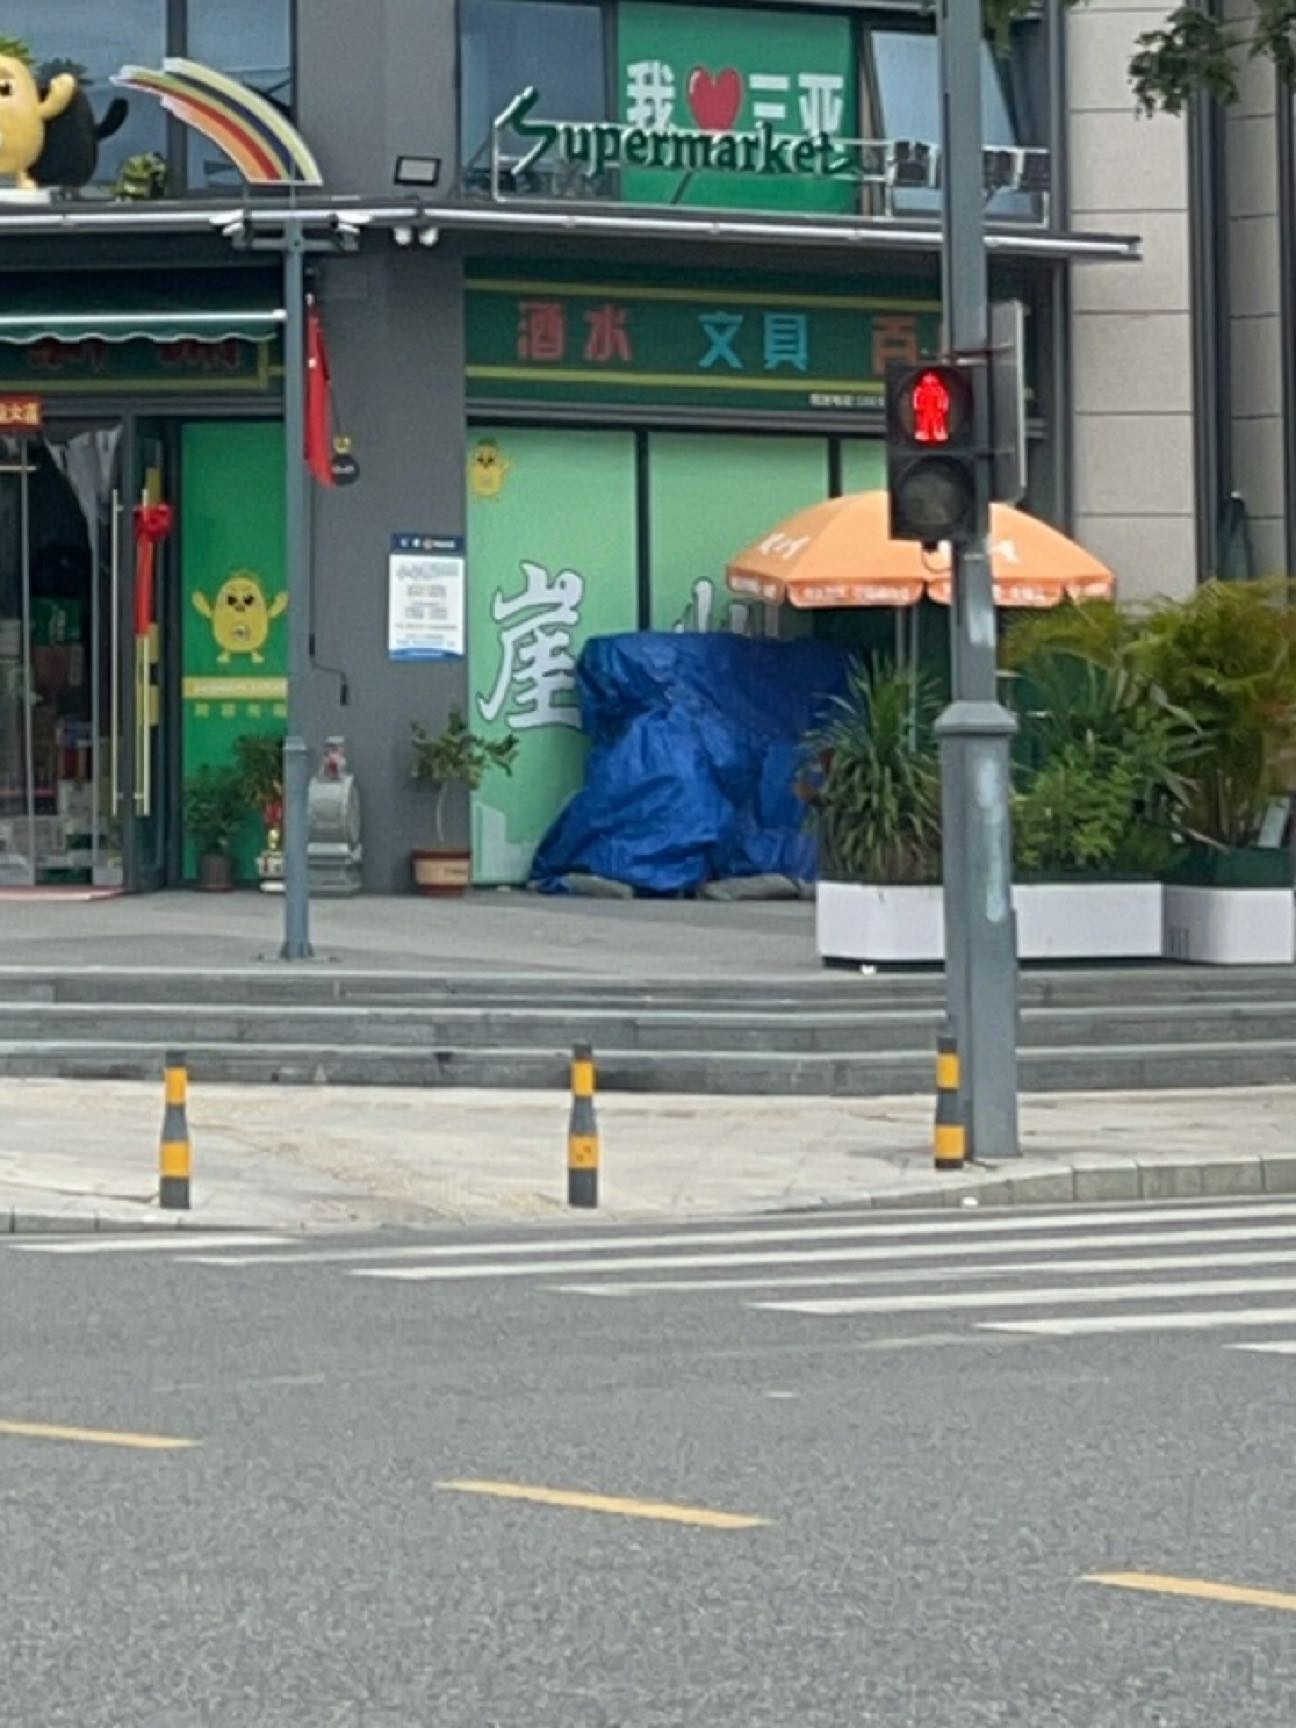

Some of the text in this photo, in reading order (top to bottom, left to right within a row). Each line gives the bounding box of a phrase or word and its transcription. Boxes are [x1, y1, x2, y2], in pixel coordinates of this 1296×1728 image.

[626, 59, 675, 129] 我
[494, 86, 856, 176] Supermarket
[517, 300, 632, 362] 酒水
[697, 311, 807, 370] 文具
